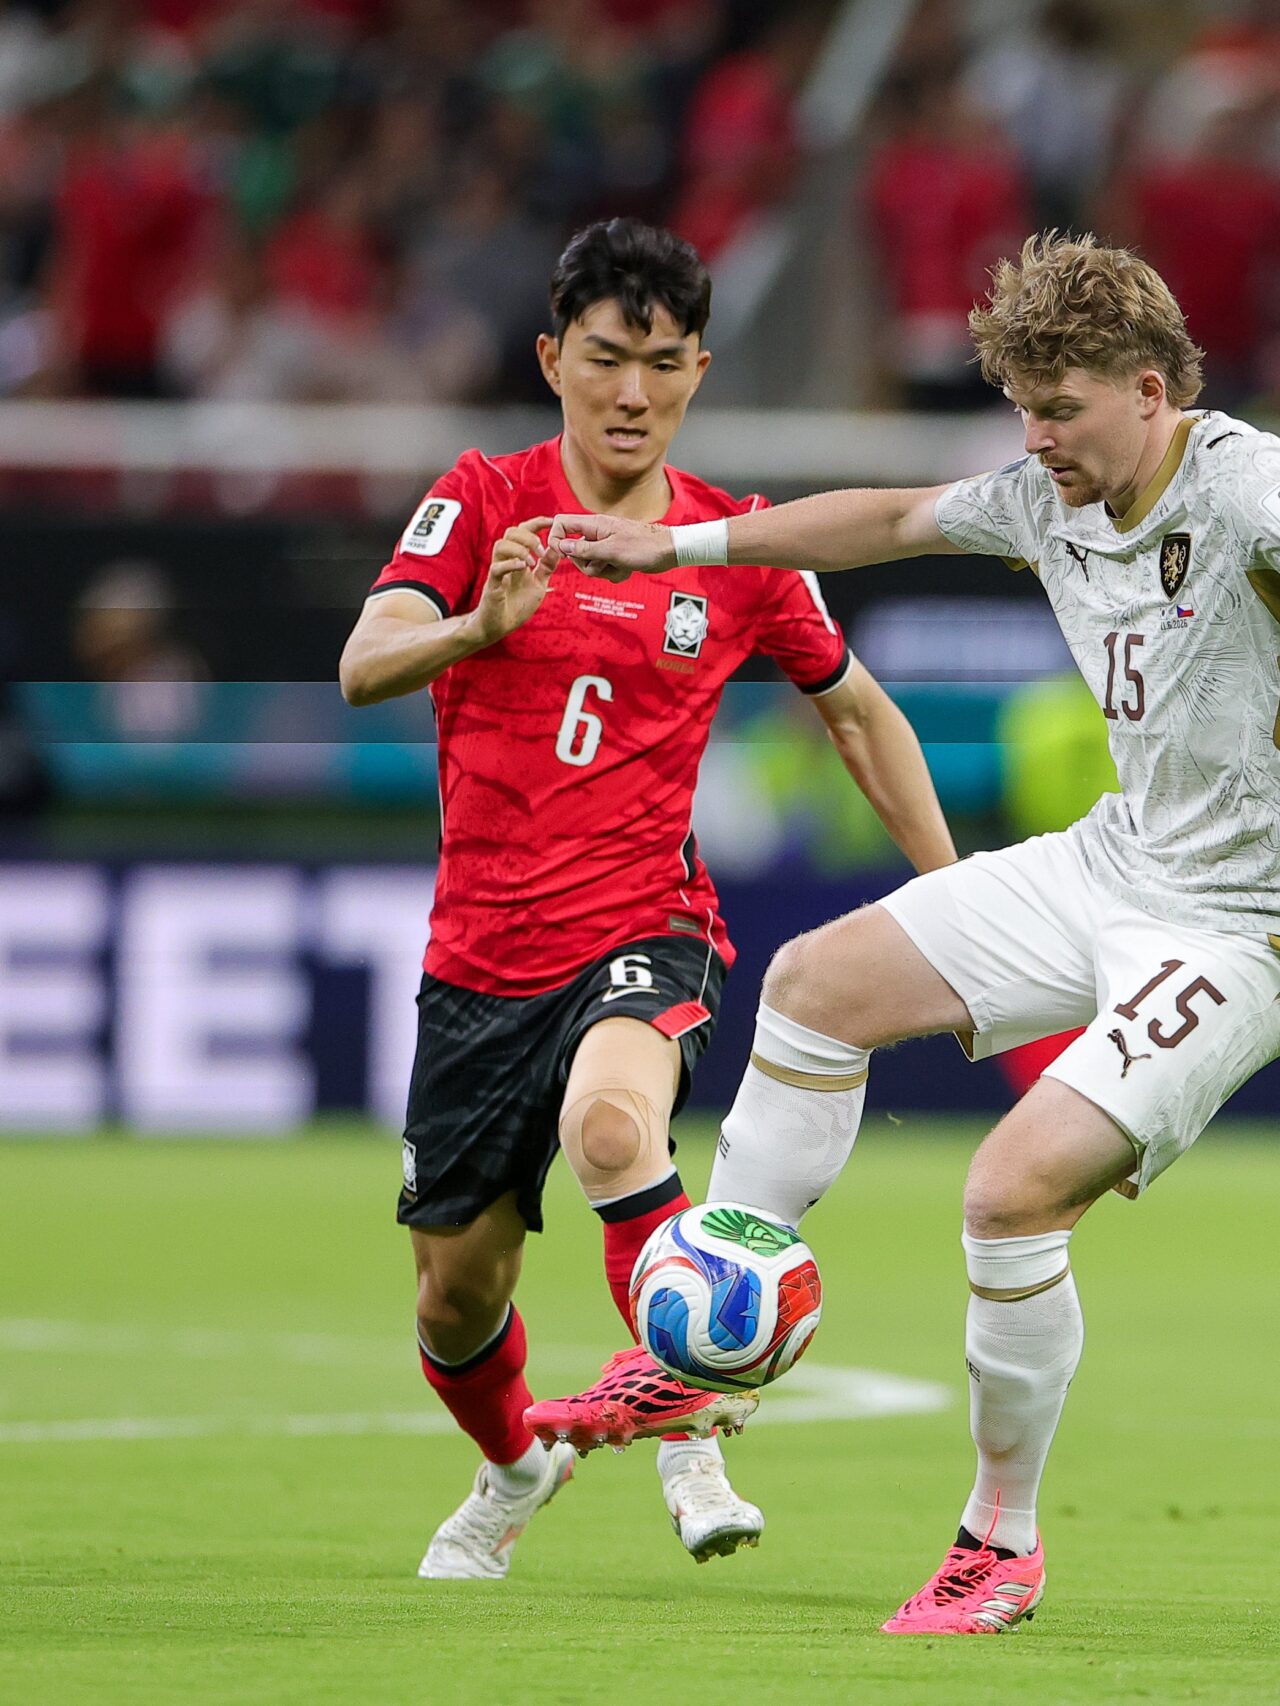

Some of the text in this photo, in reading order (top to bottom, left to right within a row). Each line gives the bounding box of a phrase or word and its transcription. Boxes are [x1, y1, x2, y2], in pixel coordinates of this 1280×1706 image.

[656, 658, 696, 674] KOREA
[1103, 632, 1145, 721] 15
[555, 674, 614, 767] 6
[609, 954, 653, 988] 6
[1113, 958, 1227, 1049] 15
